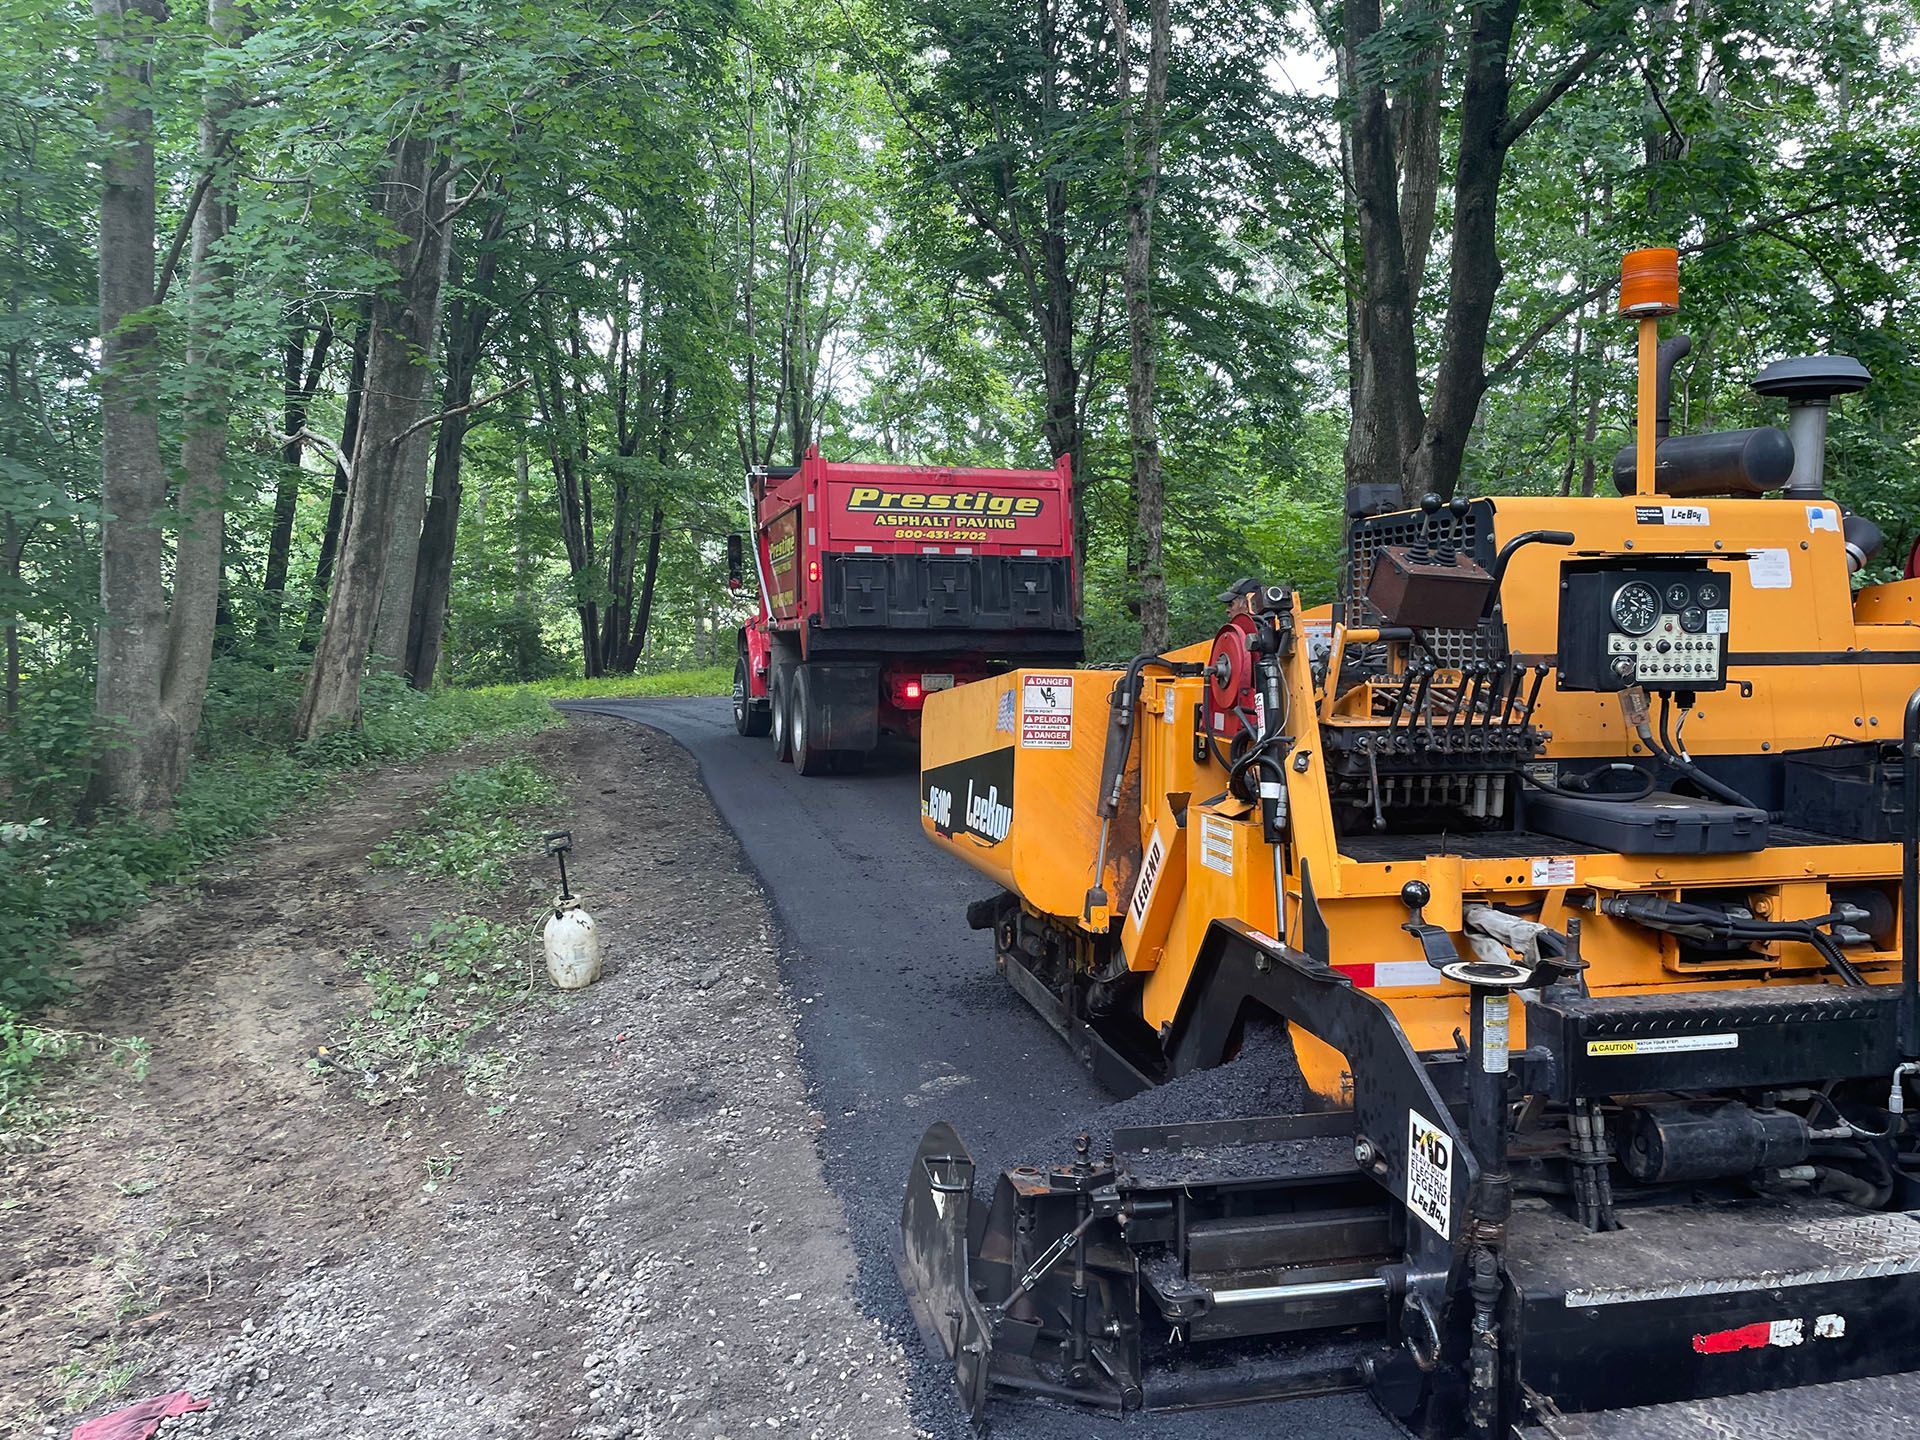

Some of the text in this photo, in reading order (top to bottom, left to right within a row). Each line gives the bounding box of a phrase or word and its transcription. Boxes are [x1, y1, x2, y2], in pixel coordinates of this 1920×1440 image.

[849, 488, 1040, 515] Prestige
[875, 515, 1016, 529] ASPHALT PAVING
[1671, 509, 1702, 522] LeeBoy
[1033, 716, 1069, 724] PELIGRO
[1034, 731, 1067, 739] DANGER
[1133, 842, 1161, 920] LEGEND
[1598, 1043, 1633, 1052] CAUTION
[1411, 1149, 1448, 1182] HEAVY DUTY
[1411, 1159, 1448, 1194] ELECTRIC
[1411, 1169, 1447, 1207] LEGEND
[1411, 1184, 1446, 1232] LeeBoy
